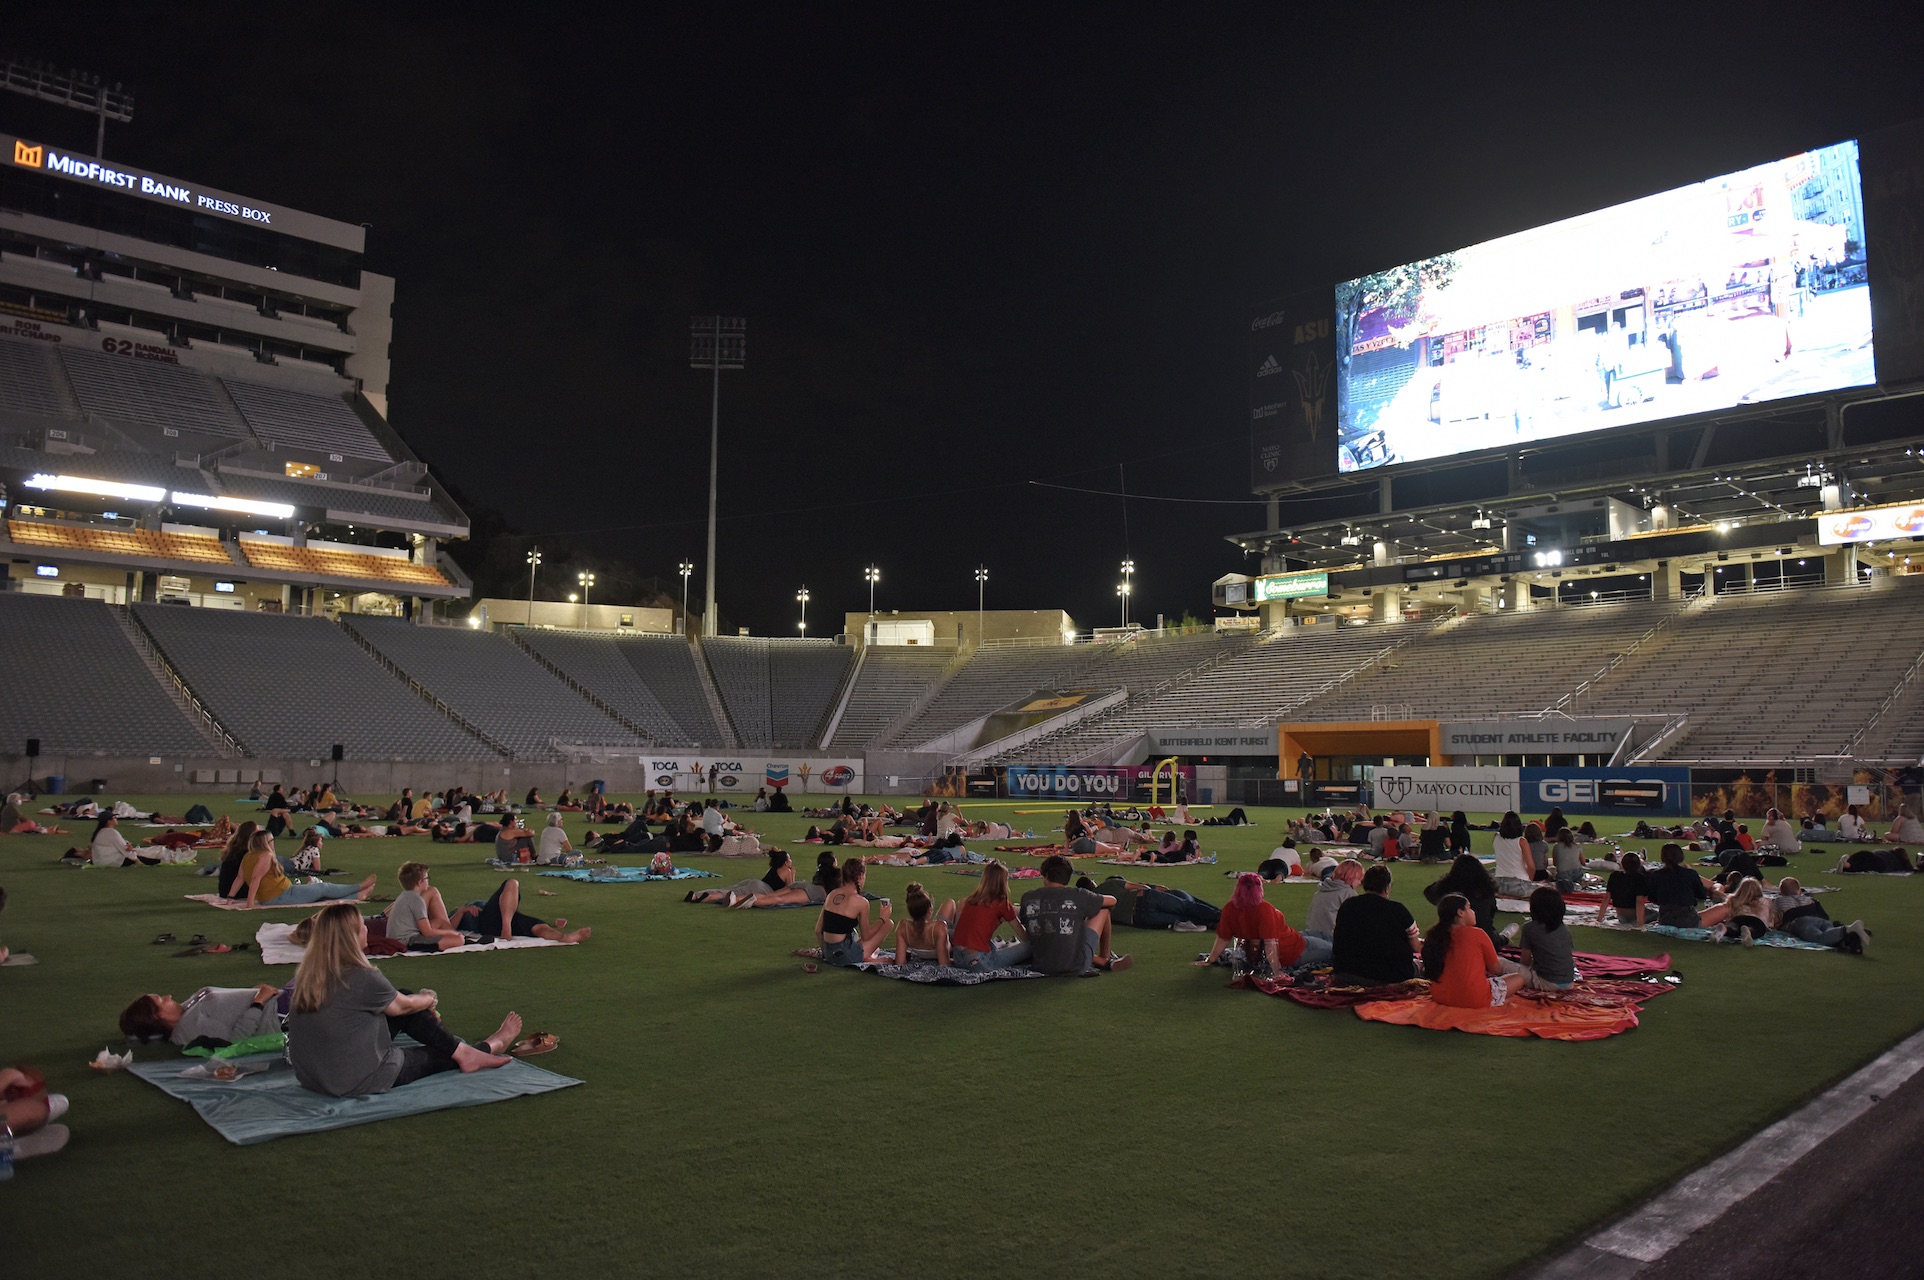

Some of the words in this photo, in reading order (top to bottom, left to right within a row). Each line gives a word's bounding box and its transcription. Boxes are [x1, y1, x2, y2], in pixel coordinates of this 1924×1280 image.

[141, 176, 191, 203] BANK
[197, 195, 240, 216] PRESS
[241, 206, 272, 224] BOX
[15, 319, 41, 332] RON
[1294, 318, 1330, 345] ASU
[102, 337, 133, 357] 62
[135, 343, 178, 357] RANDALL
[134, 350, 181, 365] McDANIEL
[1256, 365, 1283, 378] adidas
[50, 430, 66, 439] 206
[1911, 564, 1922, 573] 19
[1159, 737, 1212, 746] BUTTERFIELD
[1215, 737, 1238, 746] KENT
[1240, 737, 1269, 746] FURST
[1451, 734, 1503, 744] STUDENT
[1507, 733, 1559, 743] ATHLETE
[1563, 732, 1617, 743] FACILITY
[652, 761, 679, 771] TOCA
[715, 762, 743, 771] TOCA
[1017, 774, 1050, 792] YOU
[1054, 774, 1080, 793] DO
[1081, 775, 1120, 793] YOU
[1415, 783, 1458, 796] MAYO
[1459, 783, 1511, 797] CLINIC
